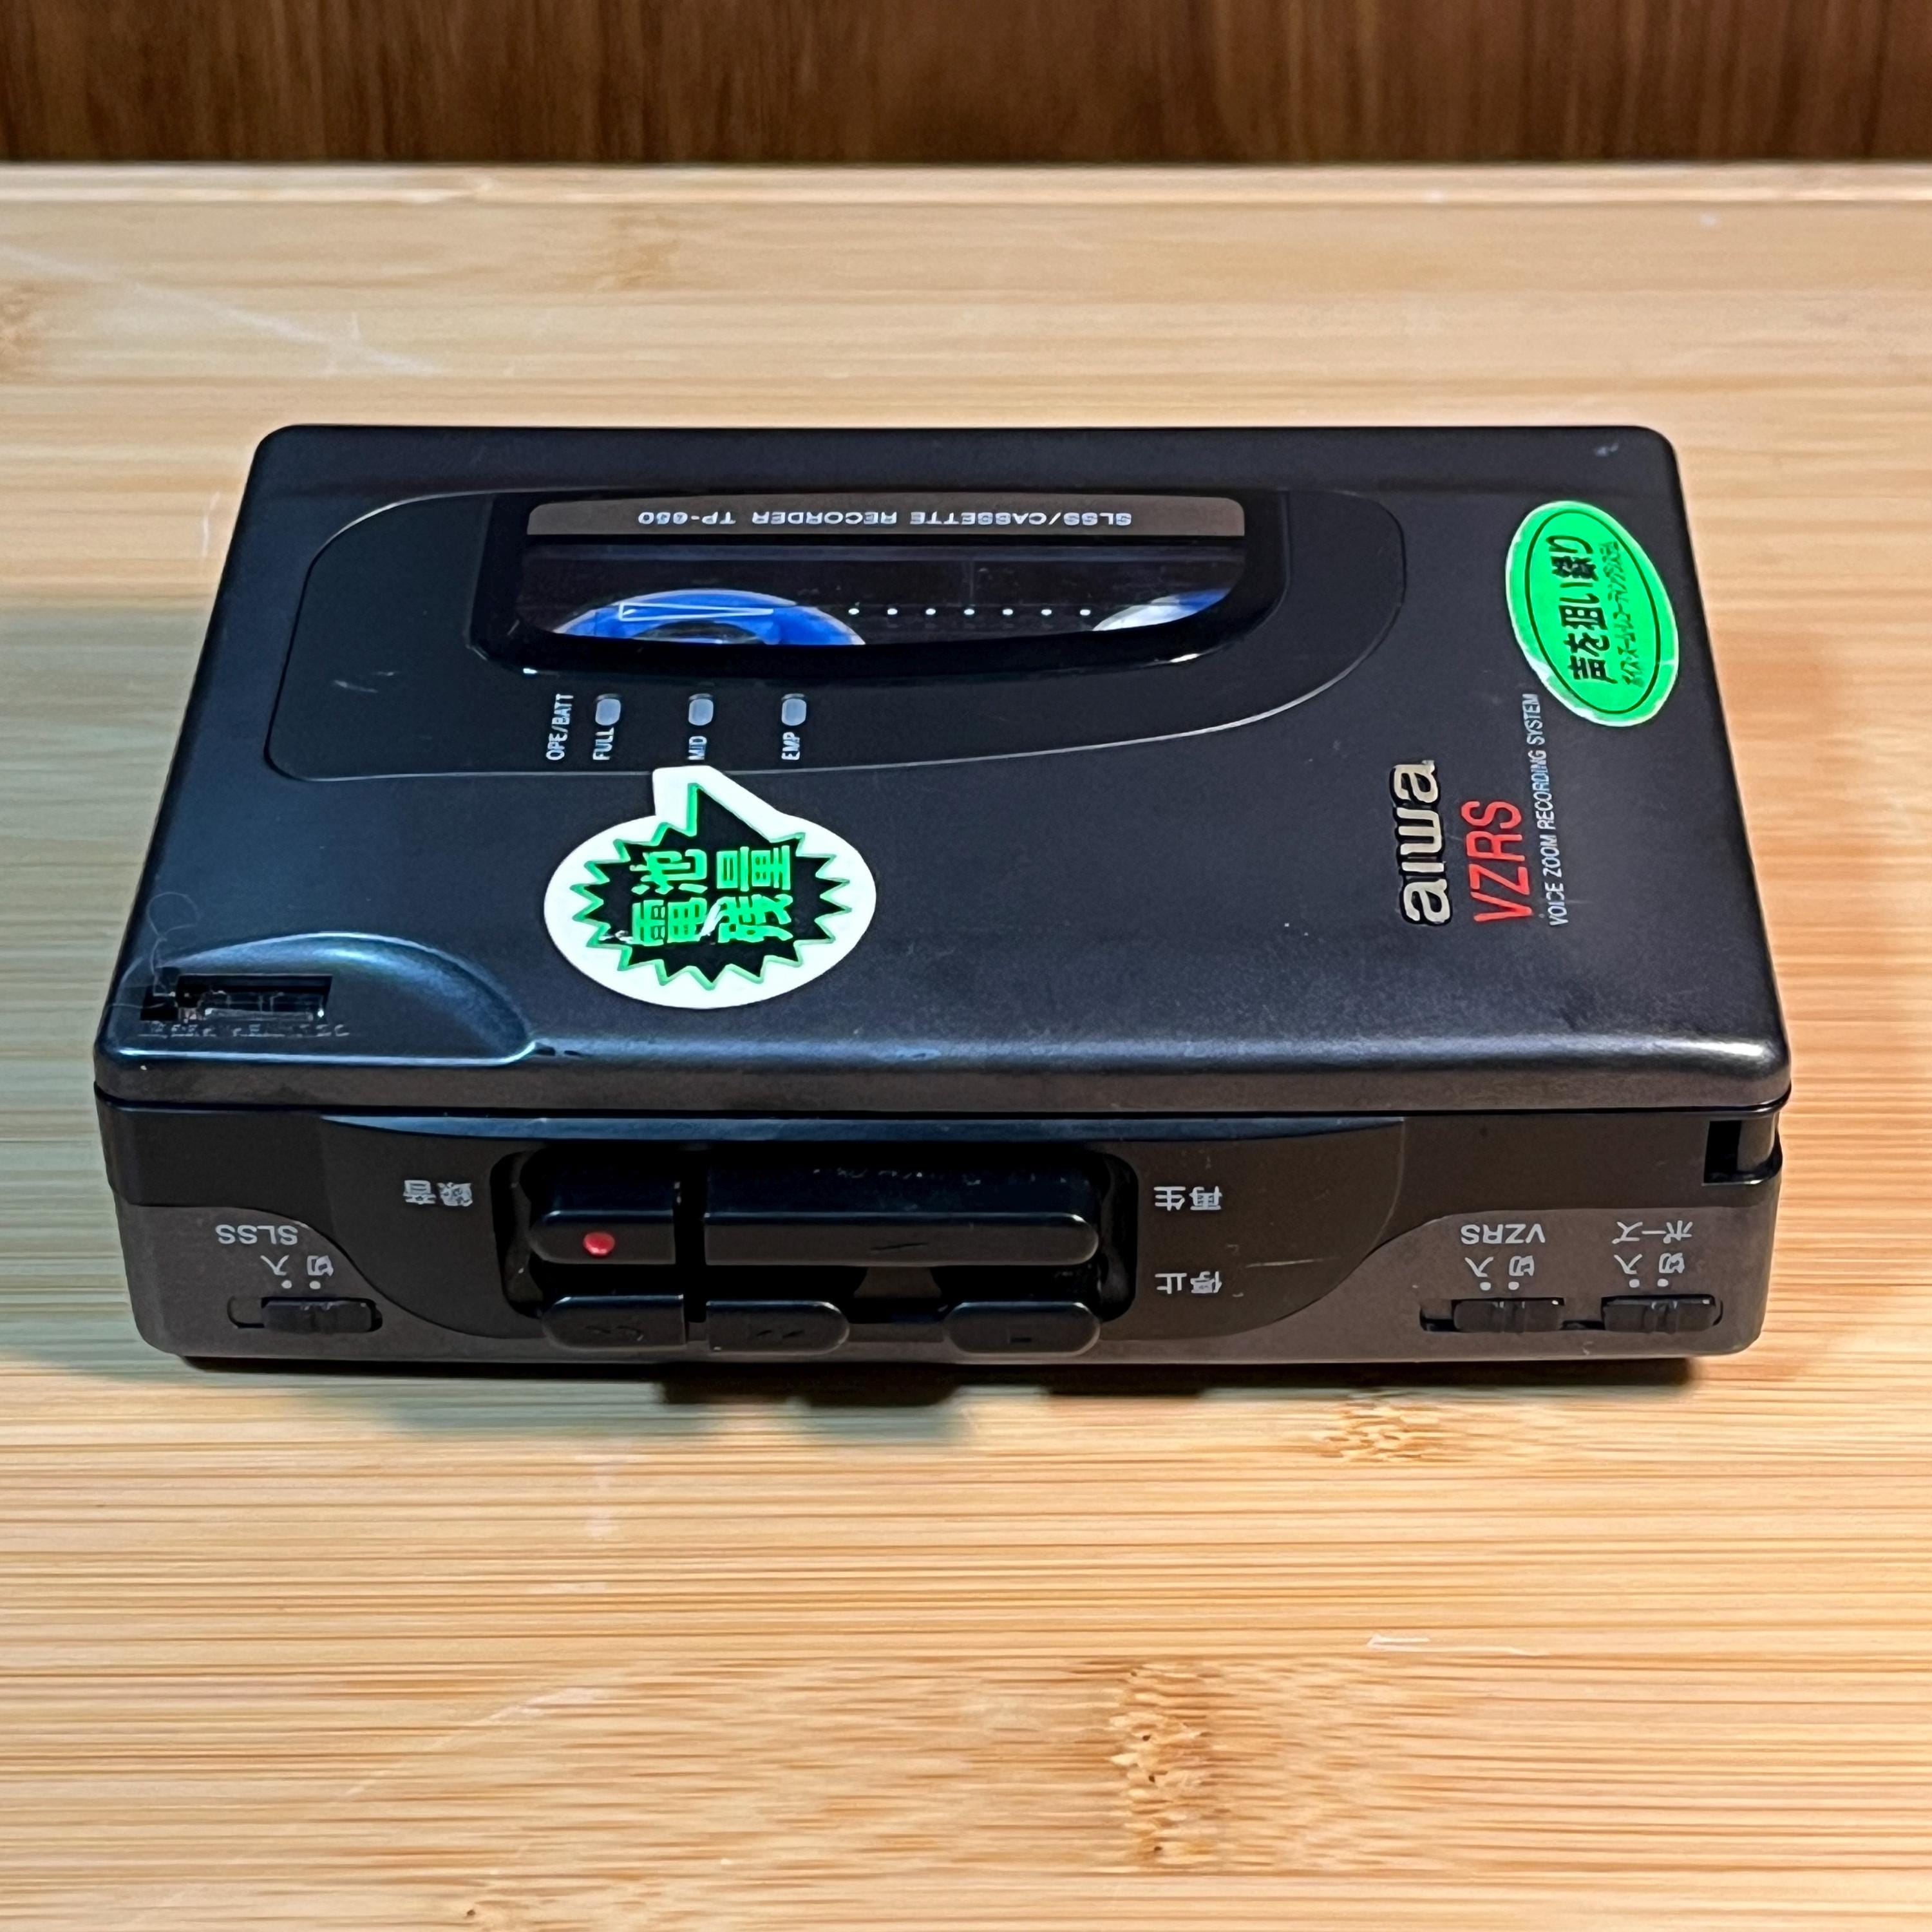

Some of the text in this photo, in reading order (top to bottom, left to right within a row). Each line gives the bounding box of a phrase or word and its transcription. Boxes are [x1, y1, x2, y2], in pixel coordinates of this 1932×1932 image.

[752, 511, 896, 526] RECORDER
[910, 511, 1132, 526] SLSS/CASSETTE
[545, 693, 574, 761] OPE/BATT
[592, 727, 614, 761] FULL
[687, 735, 708, 761] MID
[781, 732, 800, 761] EMP
[1522, 693, 1569, 926] VOICE ZOOM RECORDING SYSTEM
[1392, 759, 1452, 924] aiwa
[1461, 800, 1533, 922] VZRS
[1153, 1186, 1222, 1211] 再生
[215, 1224, 299, 1245] SLSS
[1461, 1223, 1546, 1245] VZRS
[1611, 1220, 1693, 1244] ポーズ
[1155, 1271, 1222, 1294] 停止
